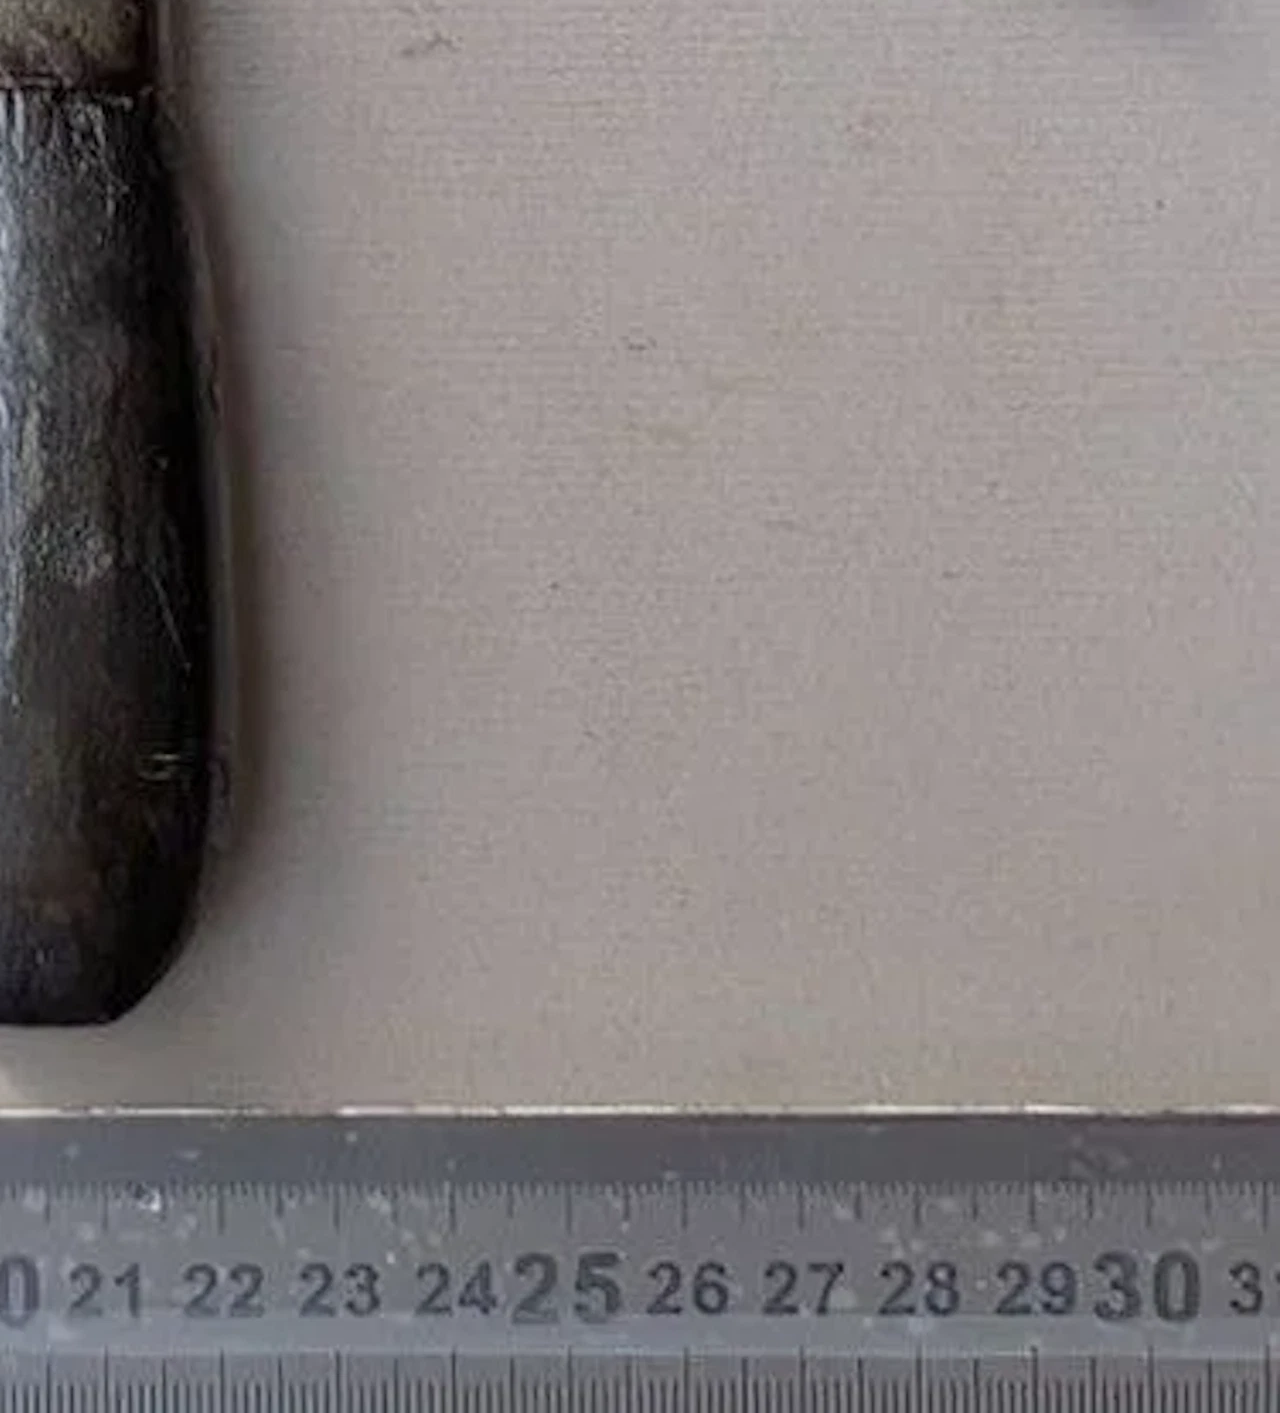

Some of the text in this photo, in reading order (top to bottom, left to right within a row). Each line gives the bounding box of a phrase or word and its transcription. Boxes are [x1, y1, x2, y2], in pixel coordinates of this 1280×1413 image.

[69, 1263, 141, 1318] 21
[184, 1264, 264, 1317] 22
[300, 1263, 381, 1316] 23
[416, 1261, 497, 1315] 24
[513, 1253, 622, 1324] 25
[646, 1261, 729, 1315] 26
[762, 1261, 845, 1316] 27
[877, 1261, 960, 1317] 28
[994, 1261, 1076, 1316] 29
[1093, 1251, 1199, 1322] 30
